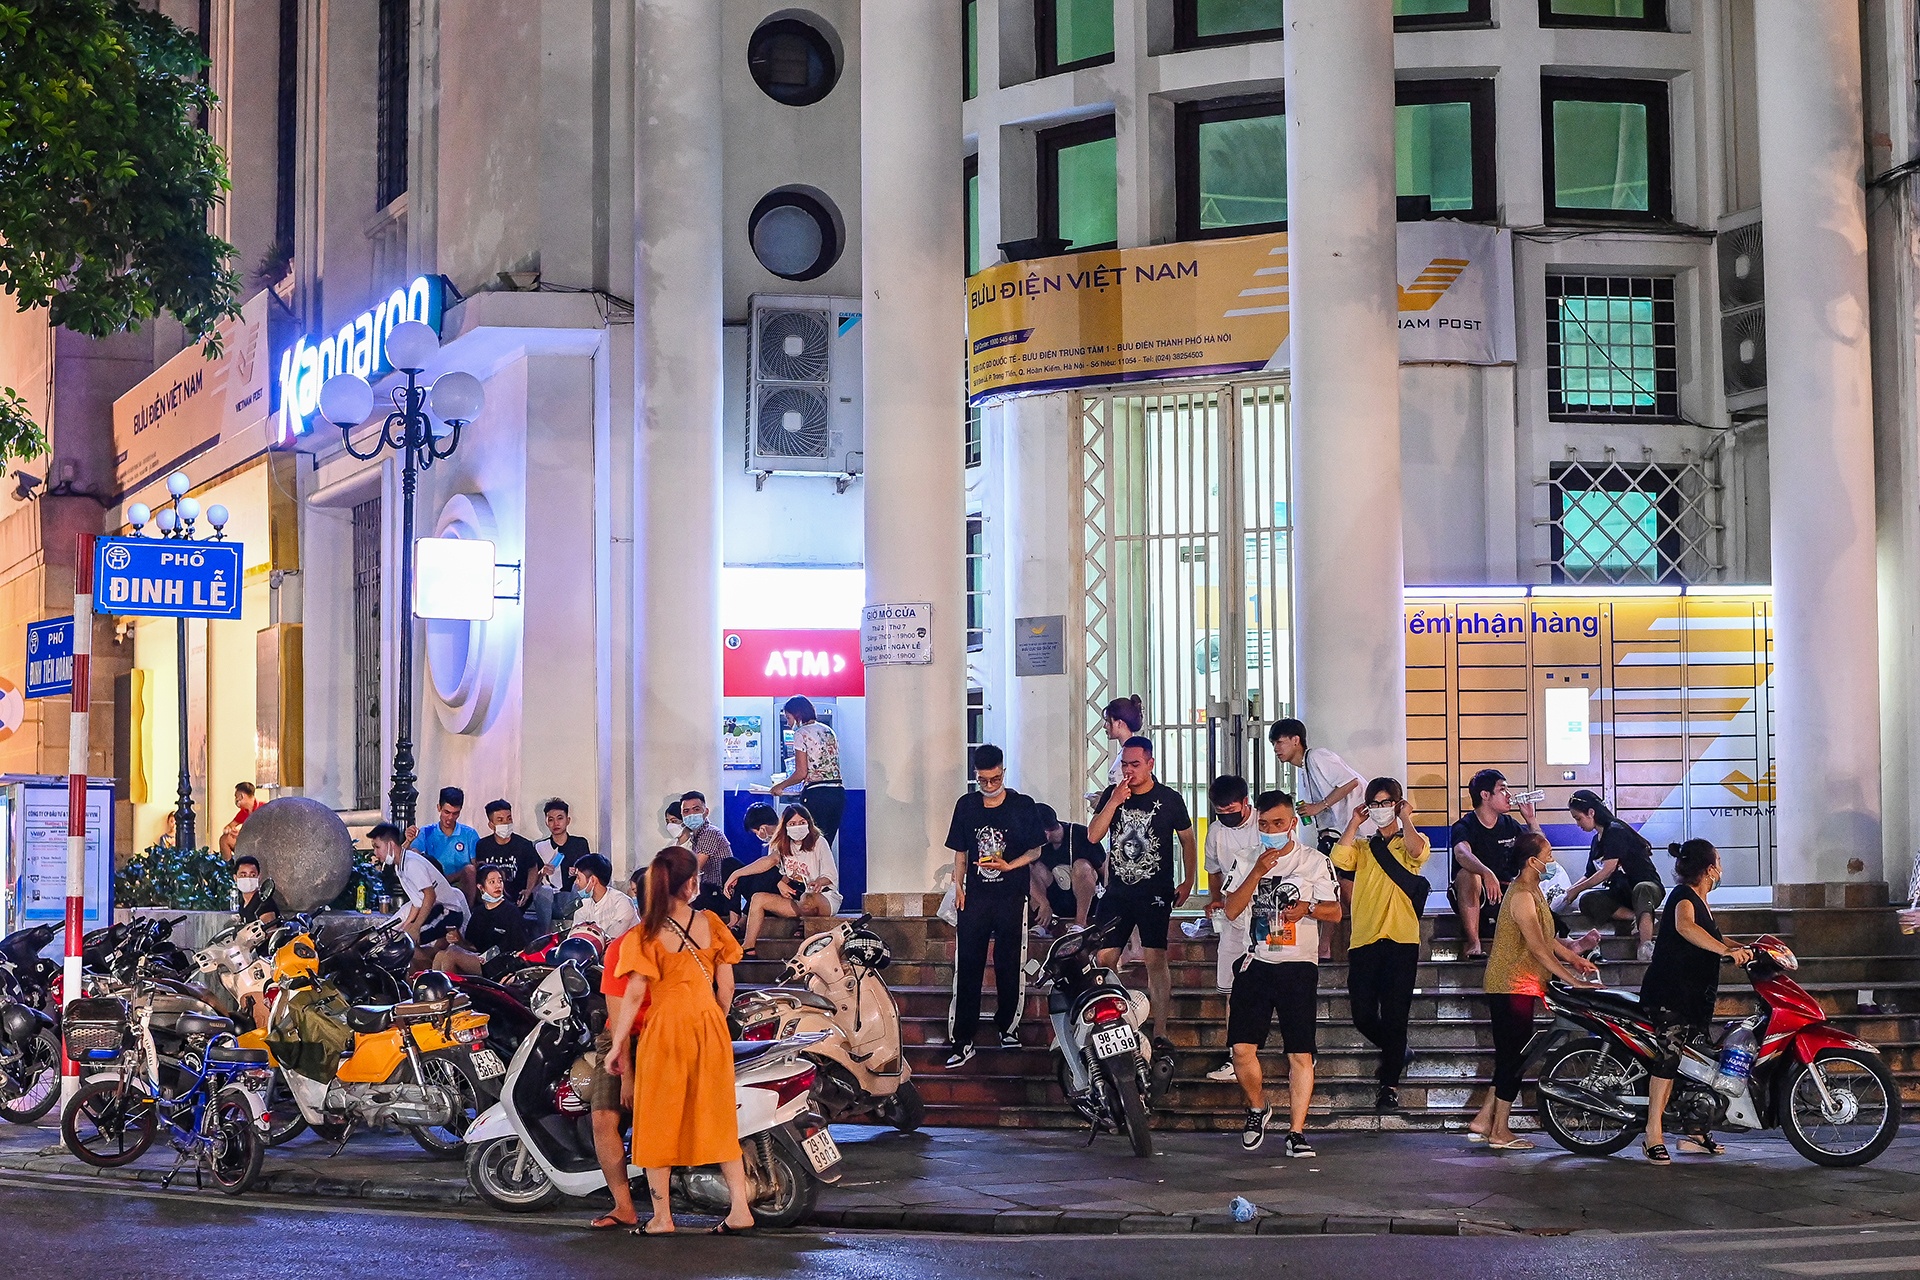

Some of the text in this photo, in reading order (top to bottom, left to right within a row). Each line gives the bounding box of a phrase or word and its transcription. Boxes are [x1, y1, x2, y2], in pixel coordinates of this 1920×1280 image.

[972, 260, 1198, 310] BƯU ĐIỆN VIỆT NAM
[1439, 318, 1482, 330] POST
[1059, 347, 1085, 356] TRUNG
[1217, 333, 1232, 342] NỘI
[134, 369, 203, 435] BƯU ĐIỆN VIỆT NAM
[161, 550, 207, 567] PHỐ
[110, 570, 226, 606] ĐINH LỄ
[895, 606, 916, 618] CỬA
[1457, 613, 1523, 637] nhận
[1531, 612, 1597, 637] hàng
[48, 626, 64, 645] PHỐ
[764, 650, 830, 677] ATM
[1709, 808, 1775, 817] VIETNAM
[1098, 1028, 1127, 1044] 98-C1
[1099, 1038, 1135, 1056] 161.98
[807, 1132, 829, 1154] 29-Y8
